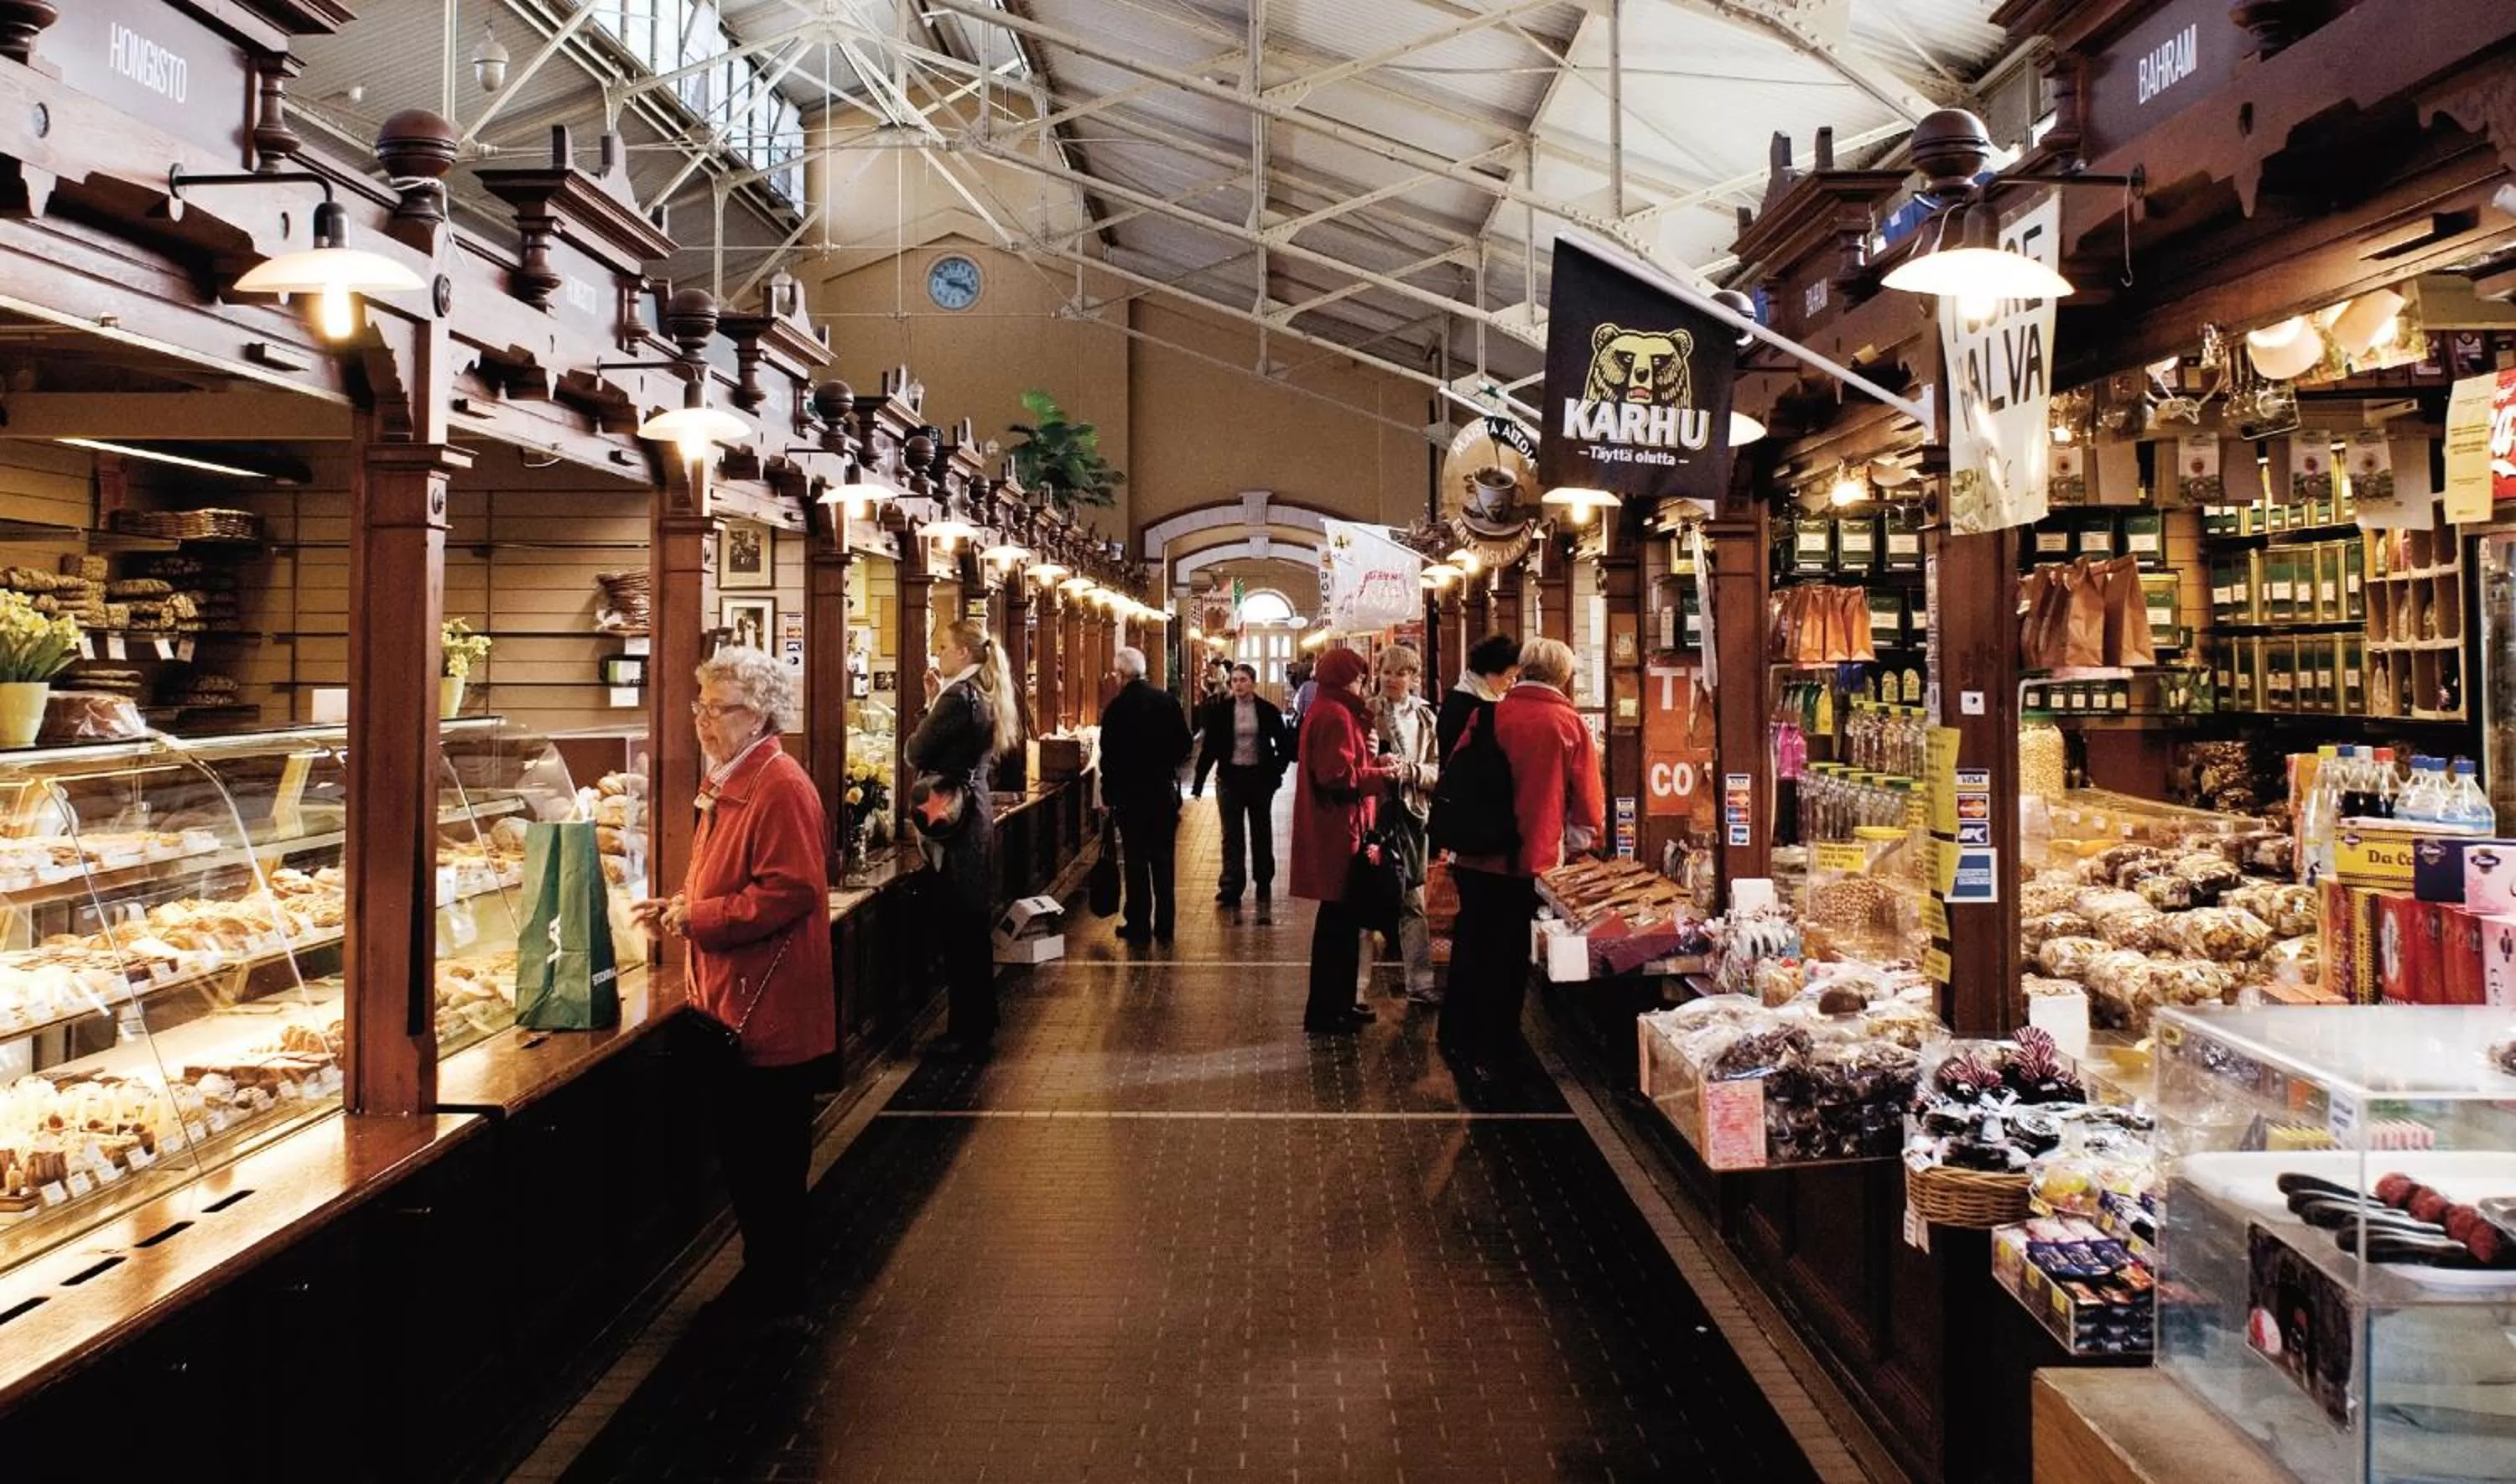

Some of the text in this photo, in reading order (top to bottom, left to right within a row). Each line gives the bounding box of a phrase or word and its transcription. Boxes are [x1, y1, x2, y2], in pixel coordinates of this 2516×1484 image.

[109, 21, 187, 103] HONGISTO
[2139, 23, 2196, 105] BAHRAM
[1562, 397, 1712, 450] KARHU
[1589, 445, 1676, 465] Täyttä olutta
